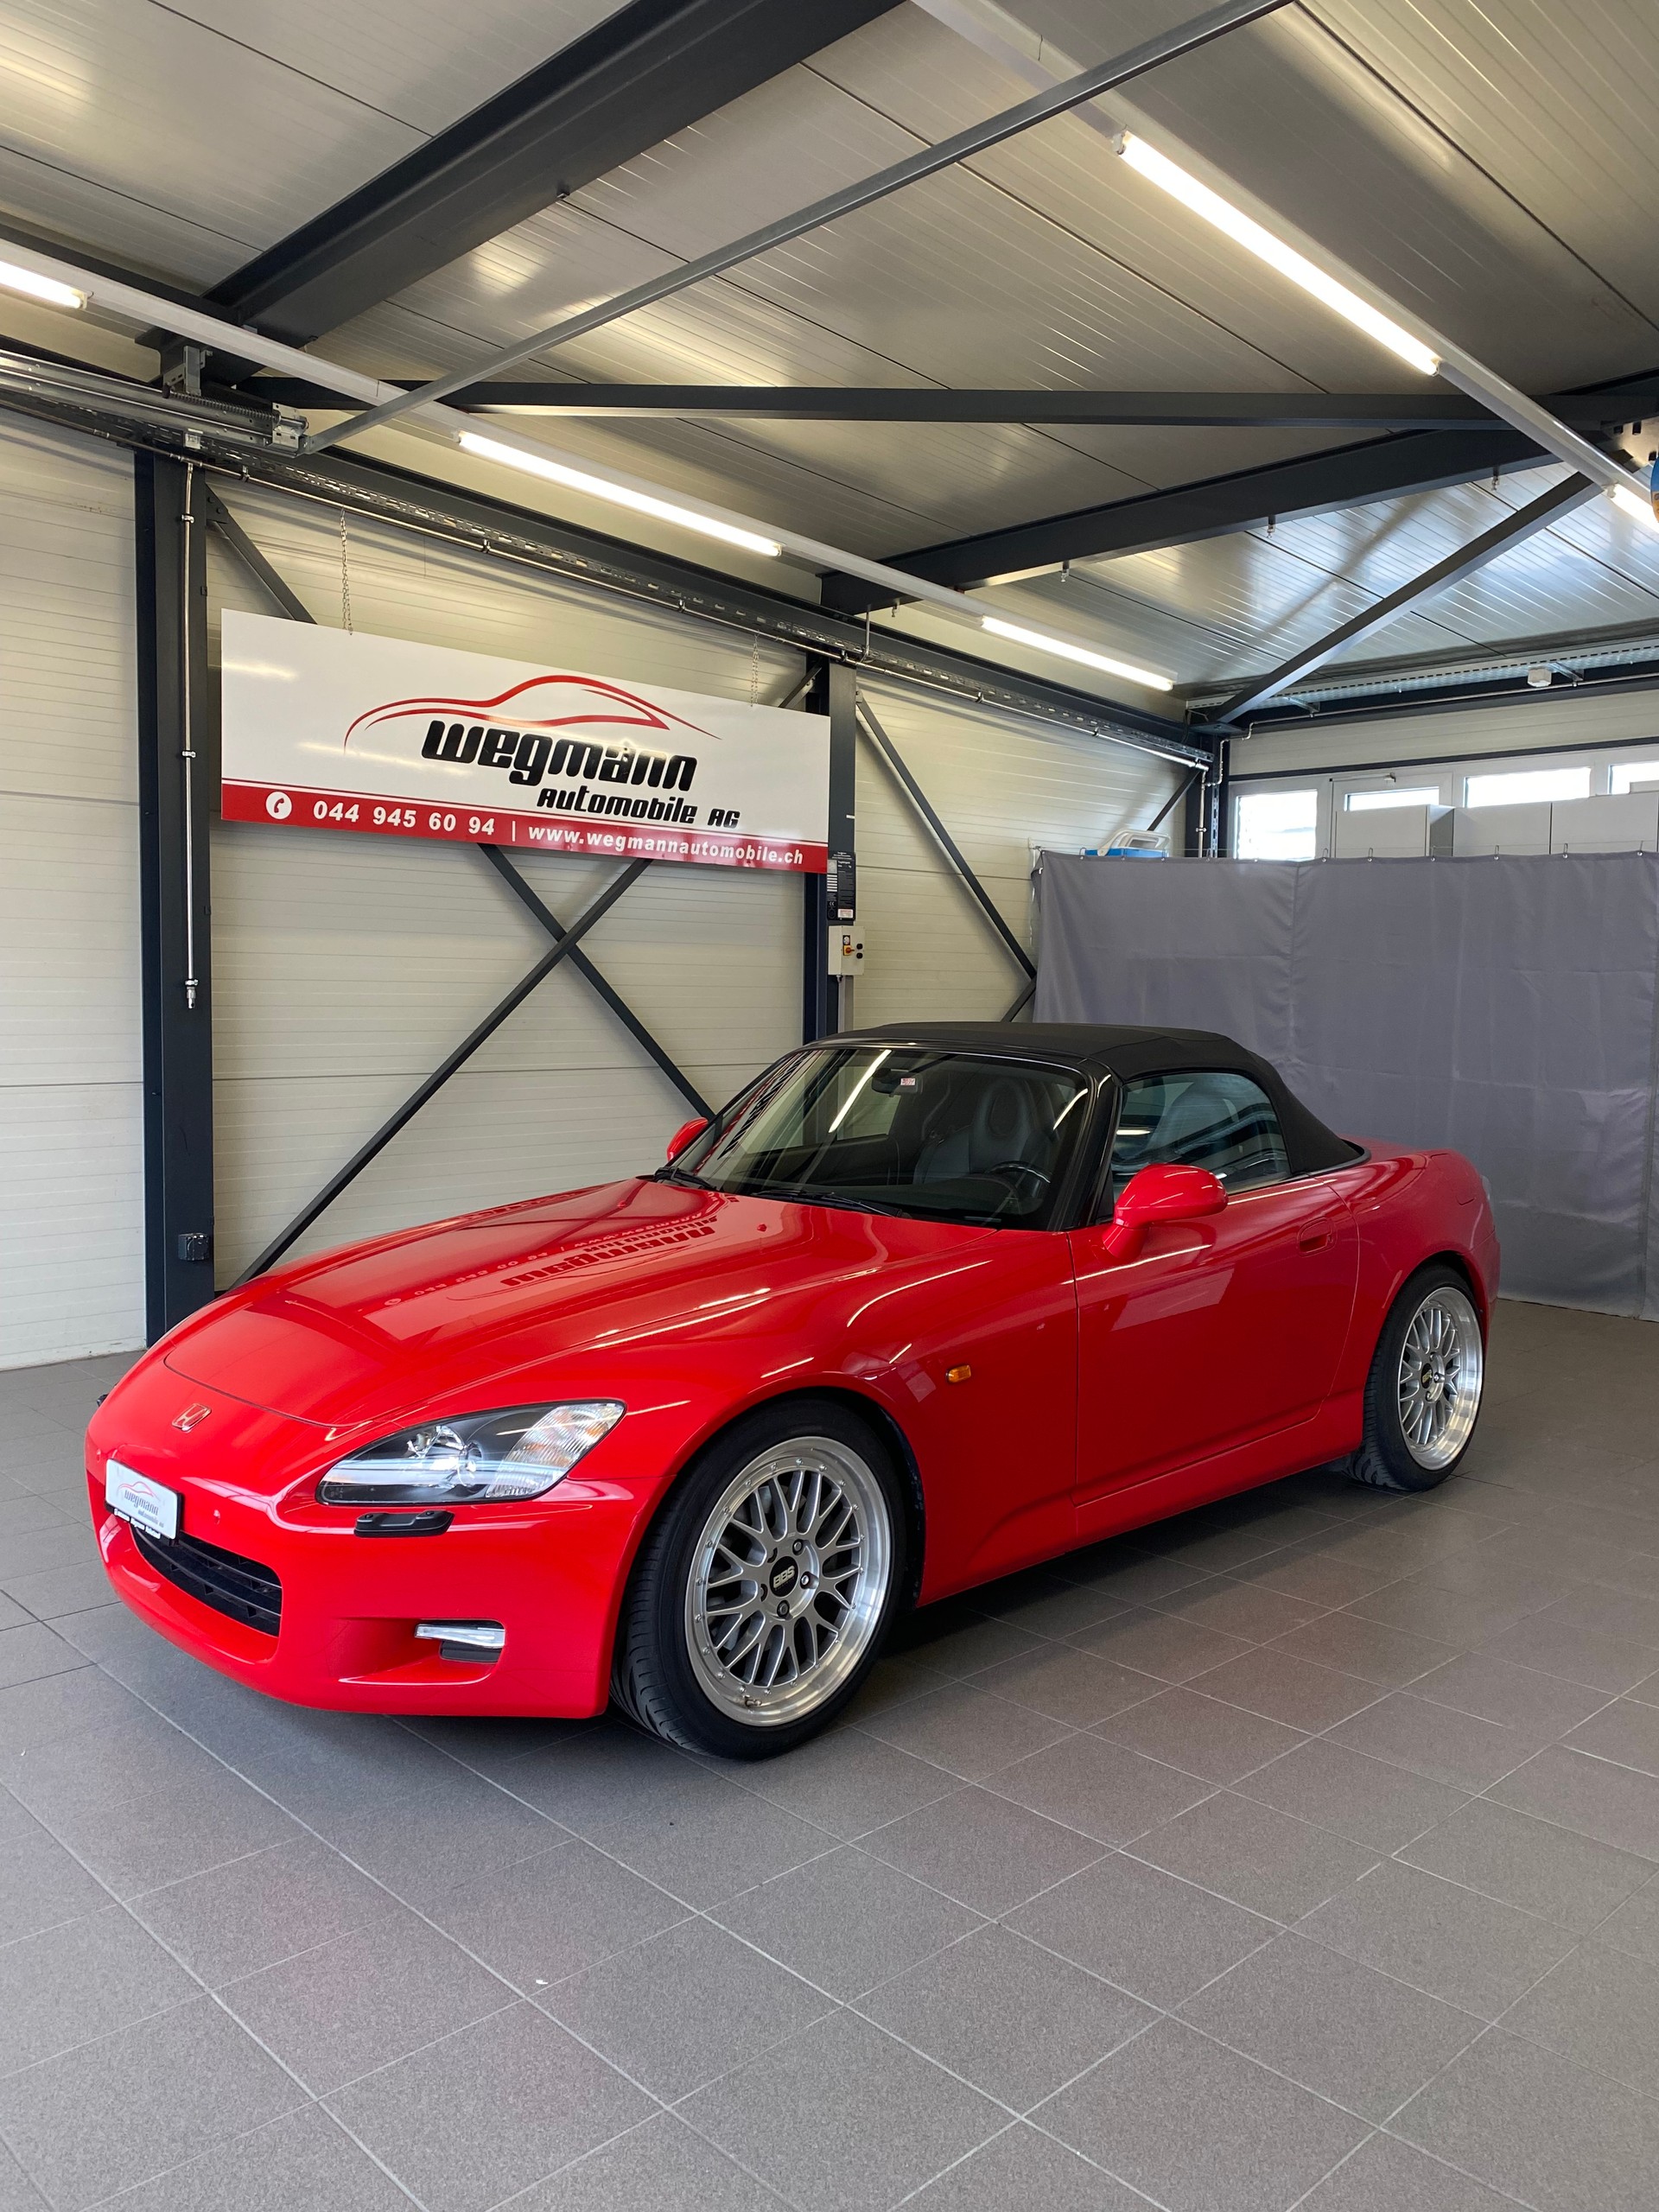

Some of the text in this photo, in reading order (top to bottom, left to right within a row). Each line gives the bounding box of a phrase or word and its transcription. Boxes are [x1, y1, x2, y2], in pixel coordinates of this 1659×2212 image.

[421, 720, 698, 791] wegmann
[313, 800, 804, 864] 044 945 60 94 www.wegmannautomobile.ch
[707, 808, 741, 830] AG
[124, 1490, 159, 1516] wegmann
[772, 1565, 795, 1589] BBS
